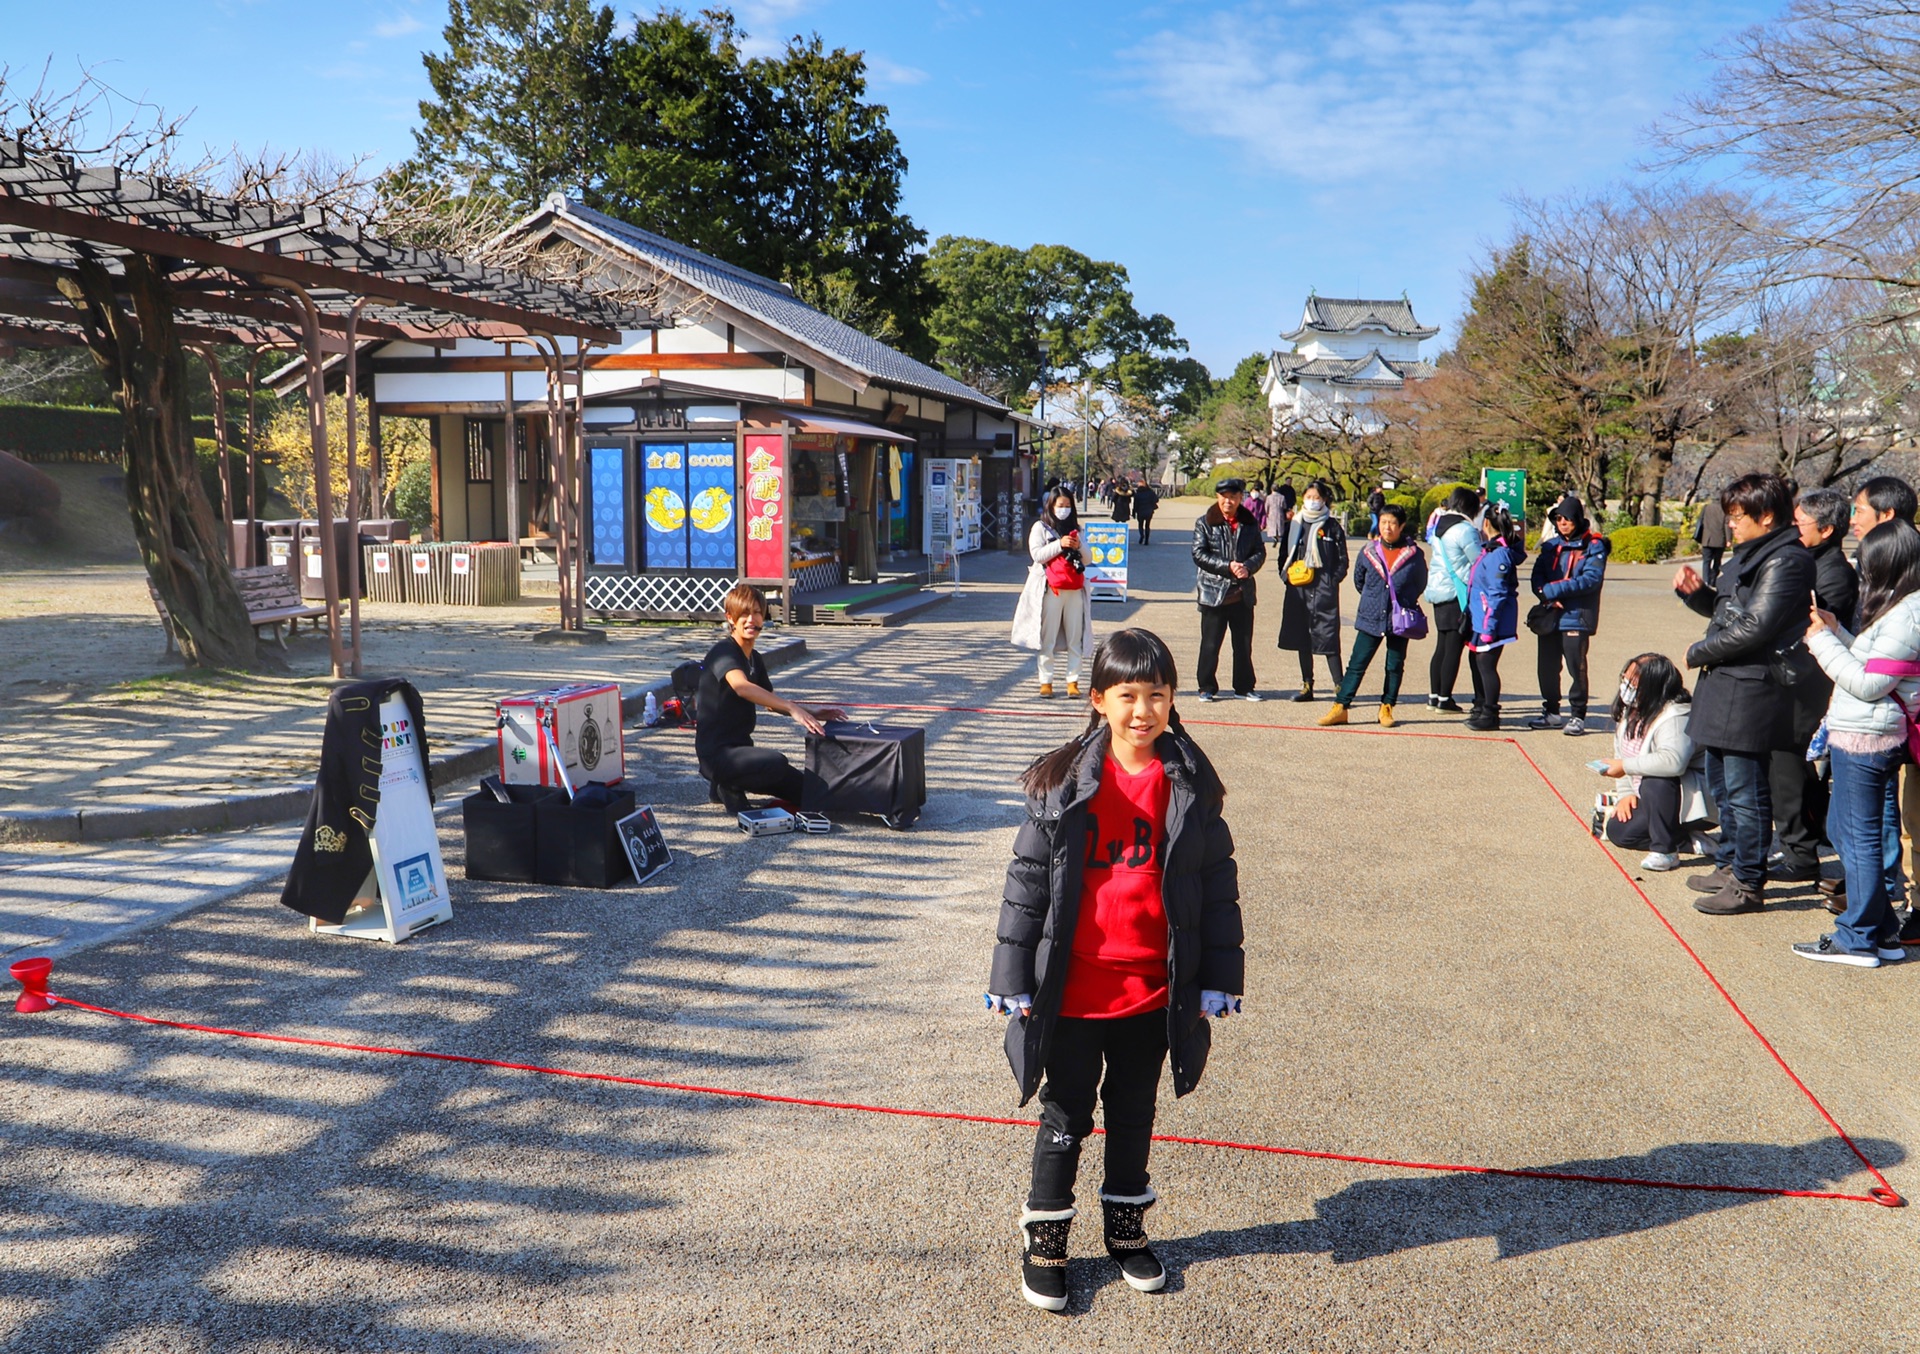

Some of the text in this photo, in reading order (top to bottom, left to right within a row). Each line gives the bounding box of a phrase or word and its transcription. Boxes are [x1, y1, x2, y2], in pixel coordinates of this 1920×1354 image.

[688, 454, 734, 467] GOODS
[746, 446, 781, 541] 金鯱の館
[391, 720, 409, 733] UP
